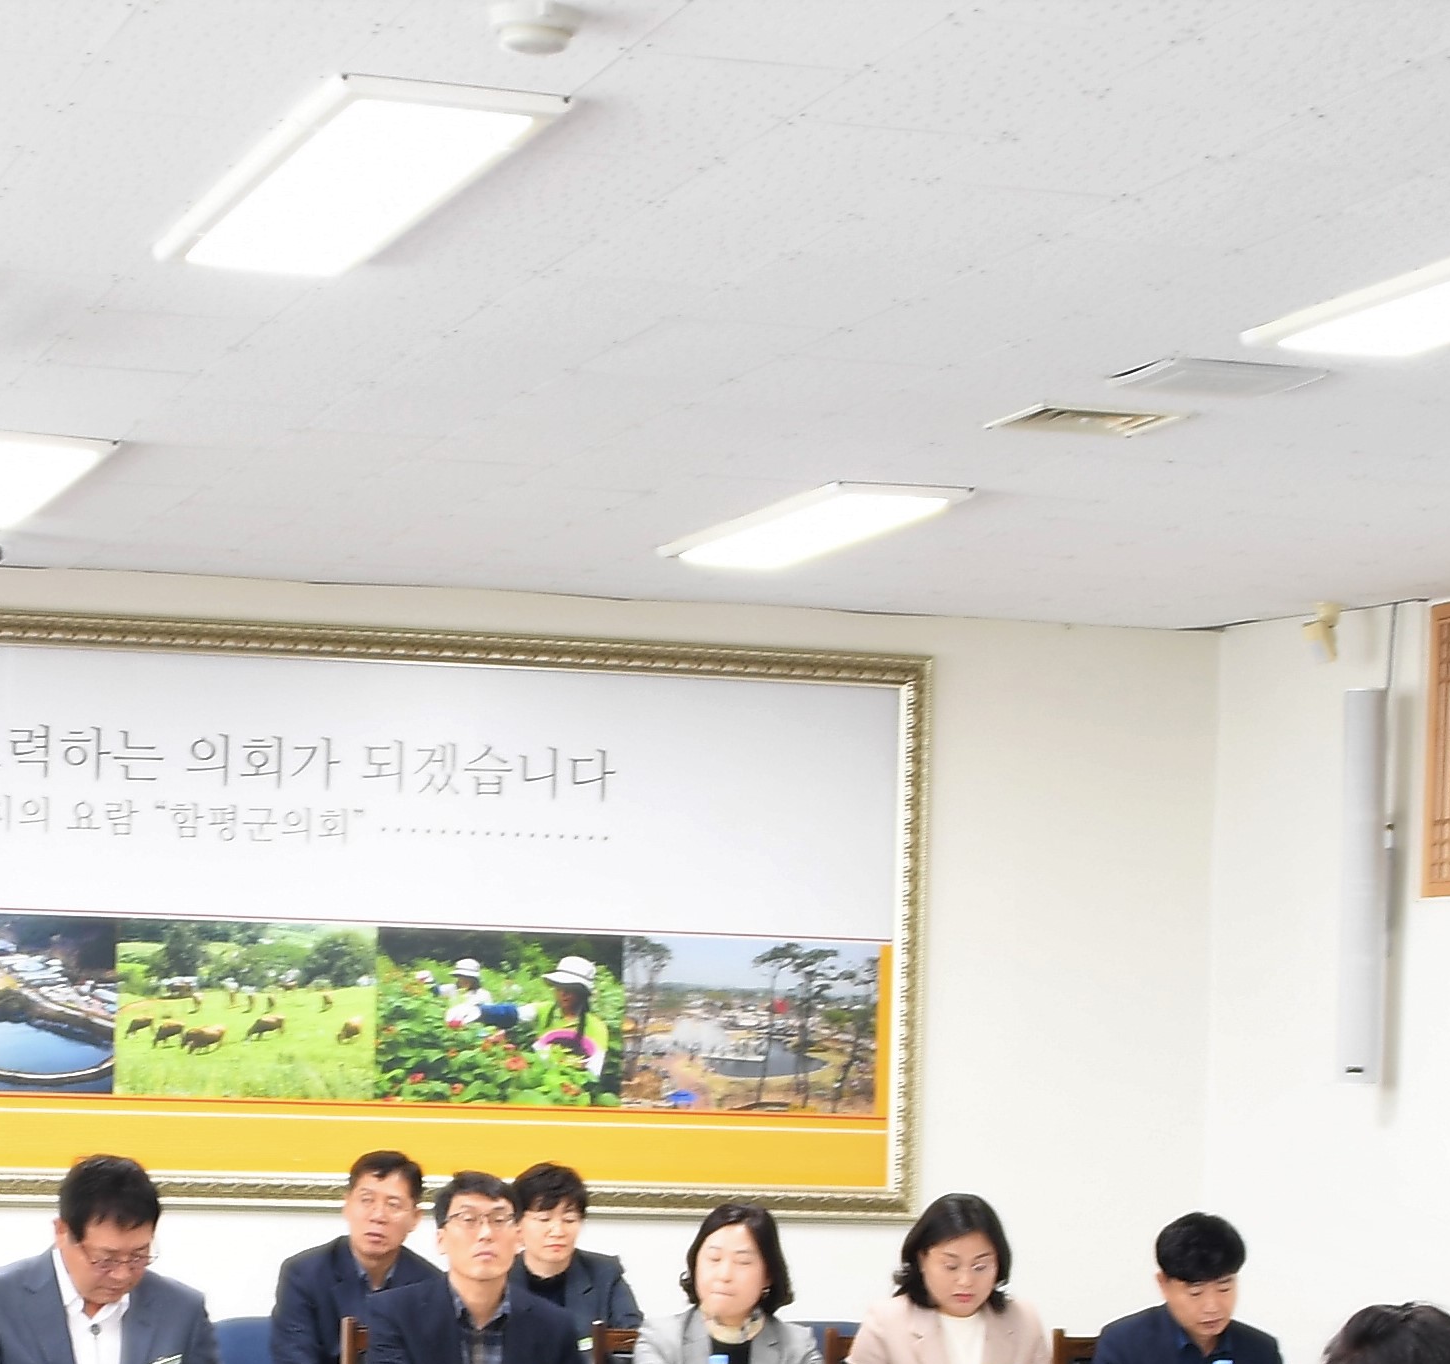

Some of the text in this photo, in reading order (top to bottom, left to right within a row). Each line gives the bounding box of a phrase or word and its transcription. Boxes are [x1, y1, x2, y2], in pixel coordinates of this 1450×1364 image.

[186, 732, 341, 790] 의회가
[362, 739, 616, 801] 되겠습니다
[66, 799, 139, 837] 요람
